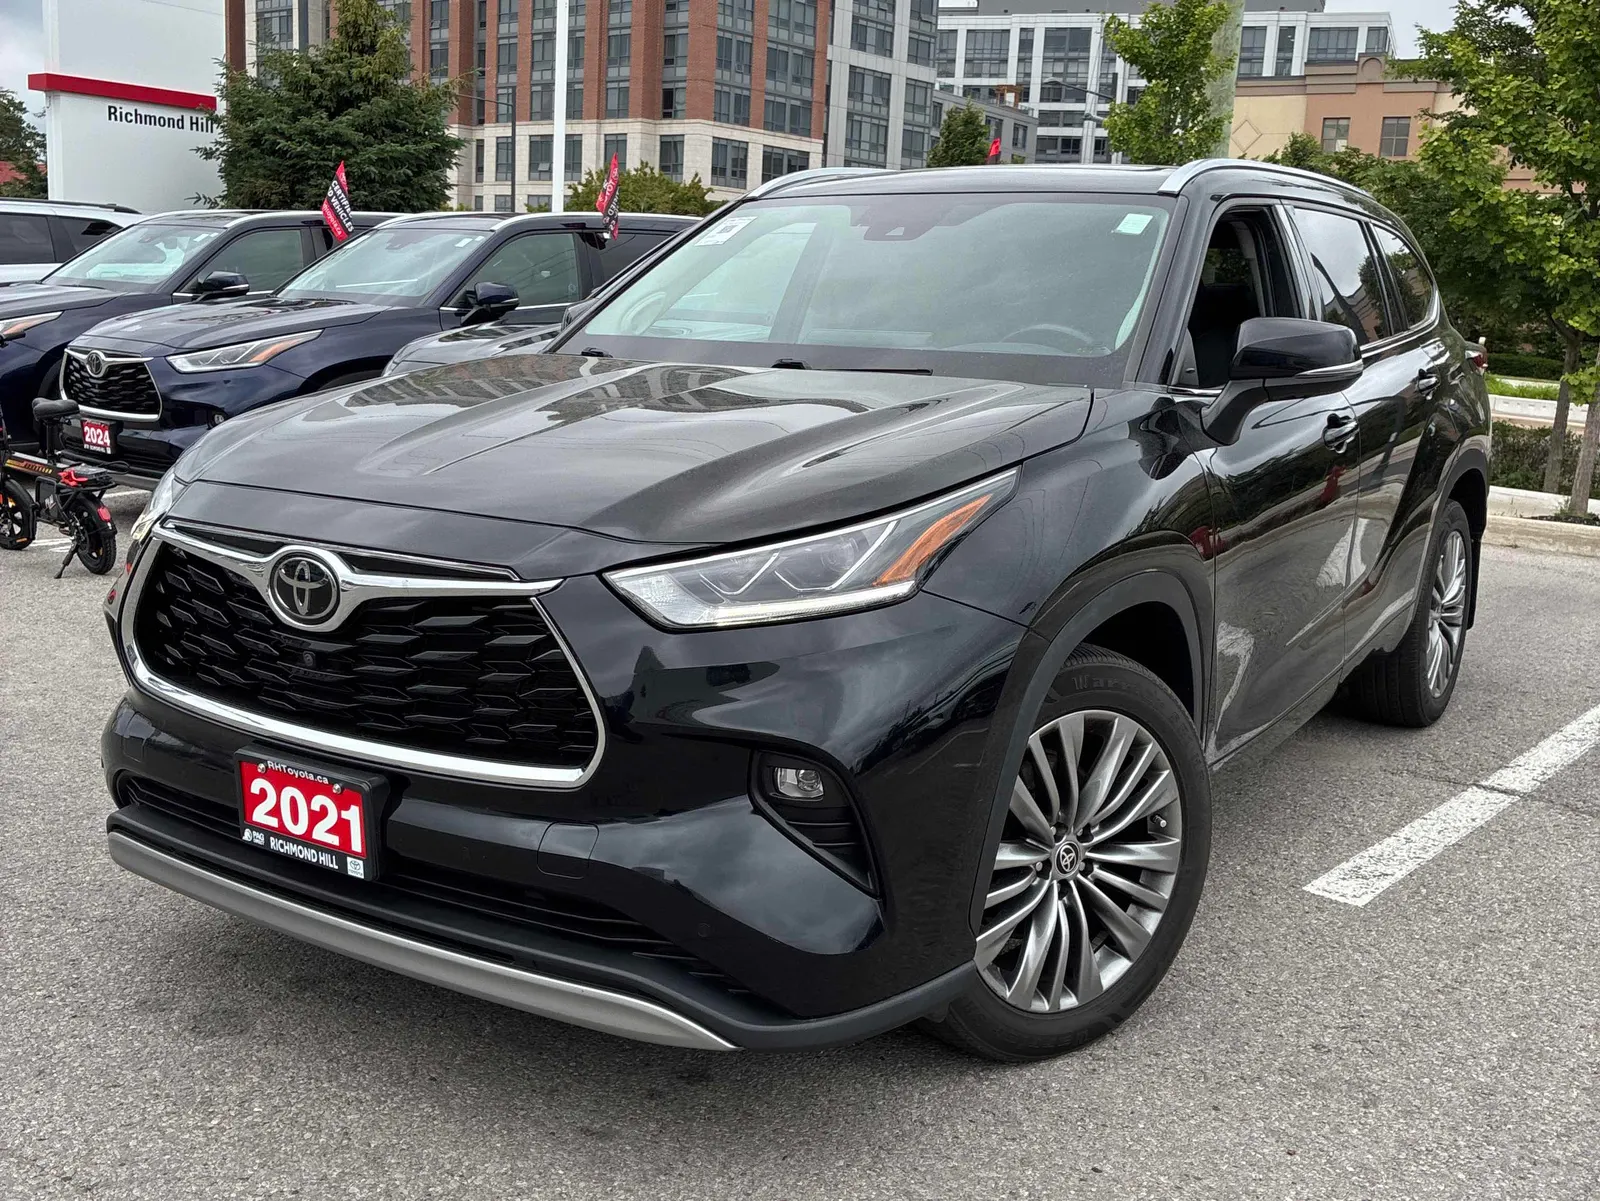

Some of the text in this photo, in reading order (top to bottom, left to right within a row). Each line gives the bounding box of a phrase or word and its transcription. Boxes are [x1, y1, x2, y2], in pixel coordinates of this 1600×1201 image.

[107, 105, 214, 133] Richmond Hill
[330, 195, 354, 233] VEHICLES
[84, 426, 110, 446] 2024
[267, 760, 329, 785] RHToyota.ca
[250, 777, 362, 853] 2021
[269, 836, 339, 870] RICHMOND HILL
